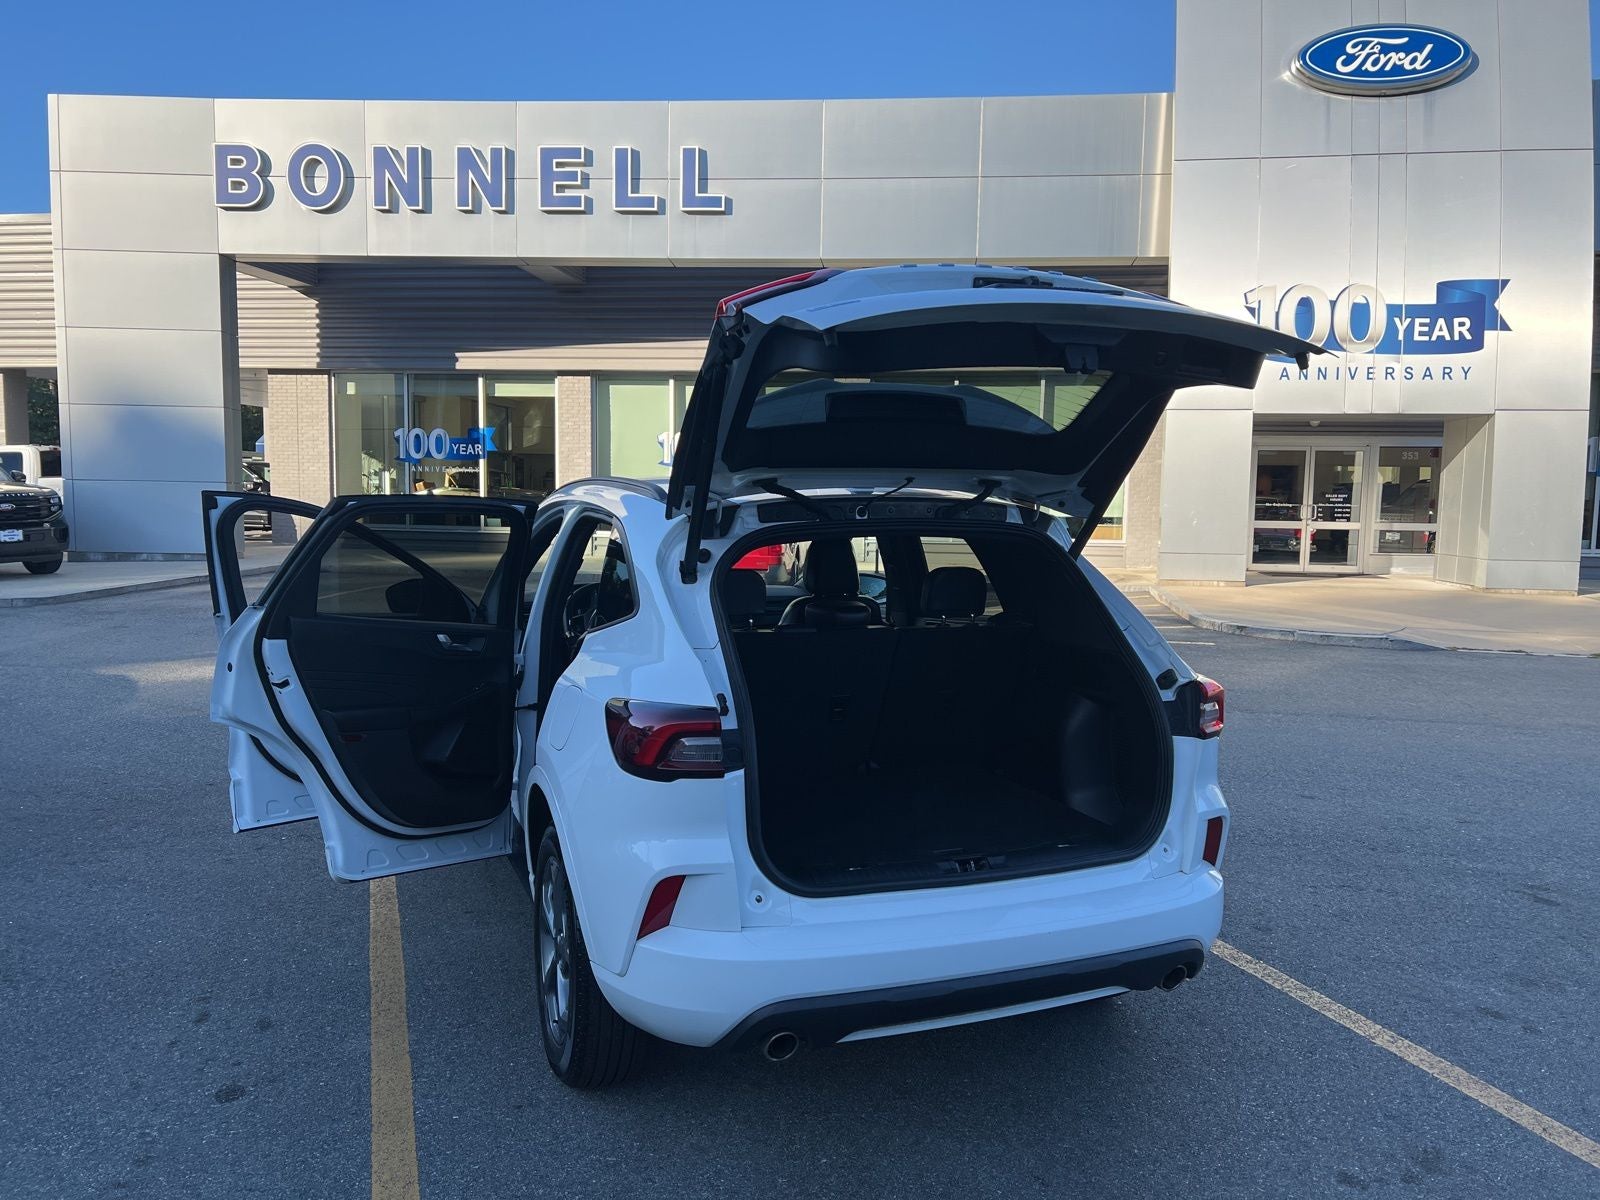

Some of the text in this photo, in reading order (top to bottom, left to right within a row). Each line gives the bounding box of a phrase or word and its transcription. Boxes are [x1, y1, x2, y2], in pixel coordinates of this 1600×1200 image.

[1335, 36, 1434, 74] Ford
[213, 142, 732, 215] BONNELL
[1243, 283, 1473, 354] 100 YEAR
[1279, 366, 1473, 381] ANNIVERSARY
[394, 428, 483, 460] 100 YEAR
[1402, 451, 1419, 460] 353
